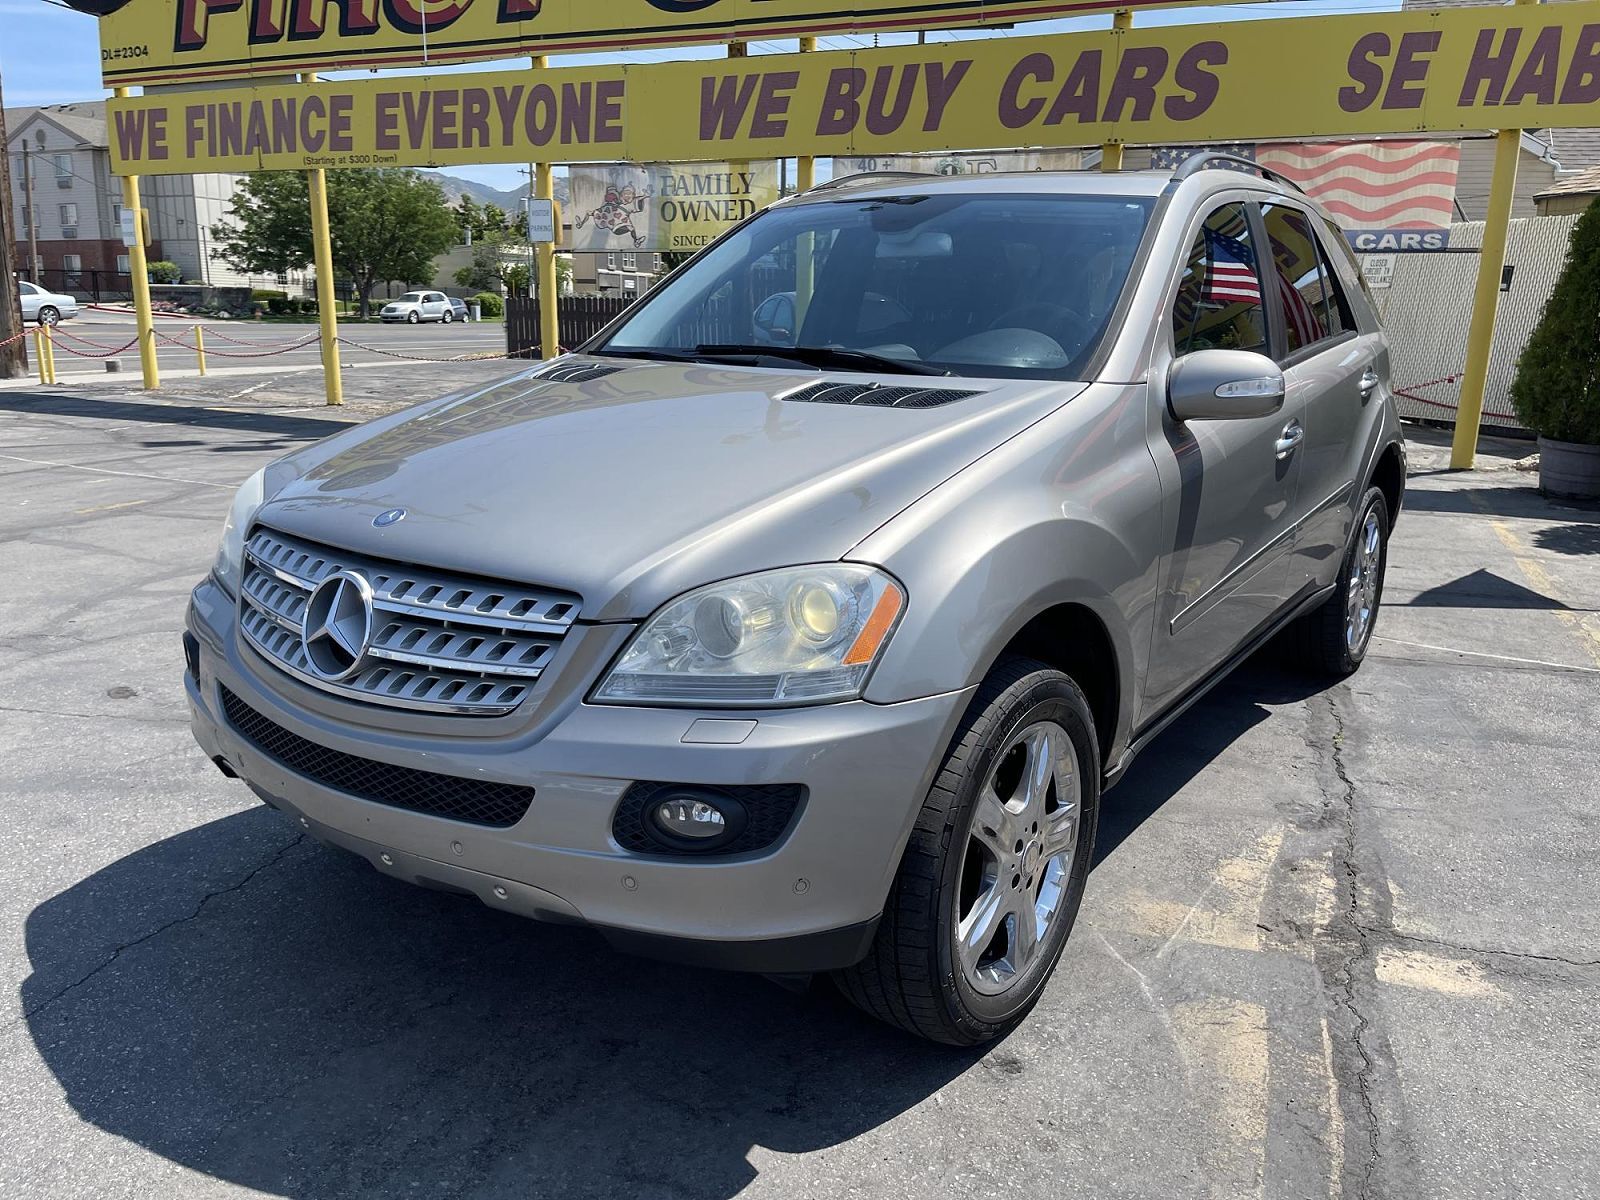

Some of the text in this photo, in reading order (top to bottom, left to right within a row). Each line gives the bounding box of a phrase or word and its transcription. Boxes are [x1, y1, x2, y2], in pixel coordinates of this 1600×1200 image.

[101, 45, 149, 60] DL#2304
[1338, 24, 1600, 112] SE HAB
[700, 41, 1229, 140] WE BUY CARS
[114, 80, 625, 161] WE FINANCE EVERYONE
[303, 156, 336, 166] (Starting
[349, 155, 370, 164] $300
[372, 153, 398, 163] Down)
[856, 158, 877, 172] 40
[660, 172, 755, 196] FAMILY
[660, 199, 756, 222] OWNED
[673, 235, 708, 246] SINCE
[1355, 233, 1443, 249] CARS
